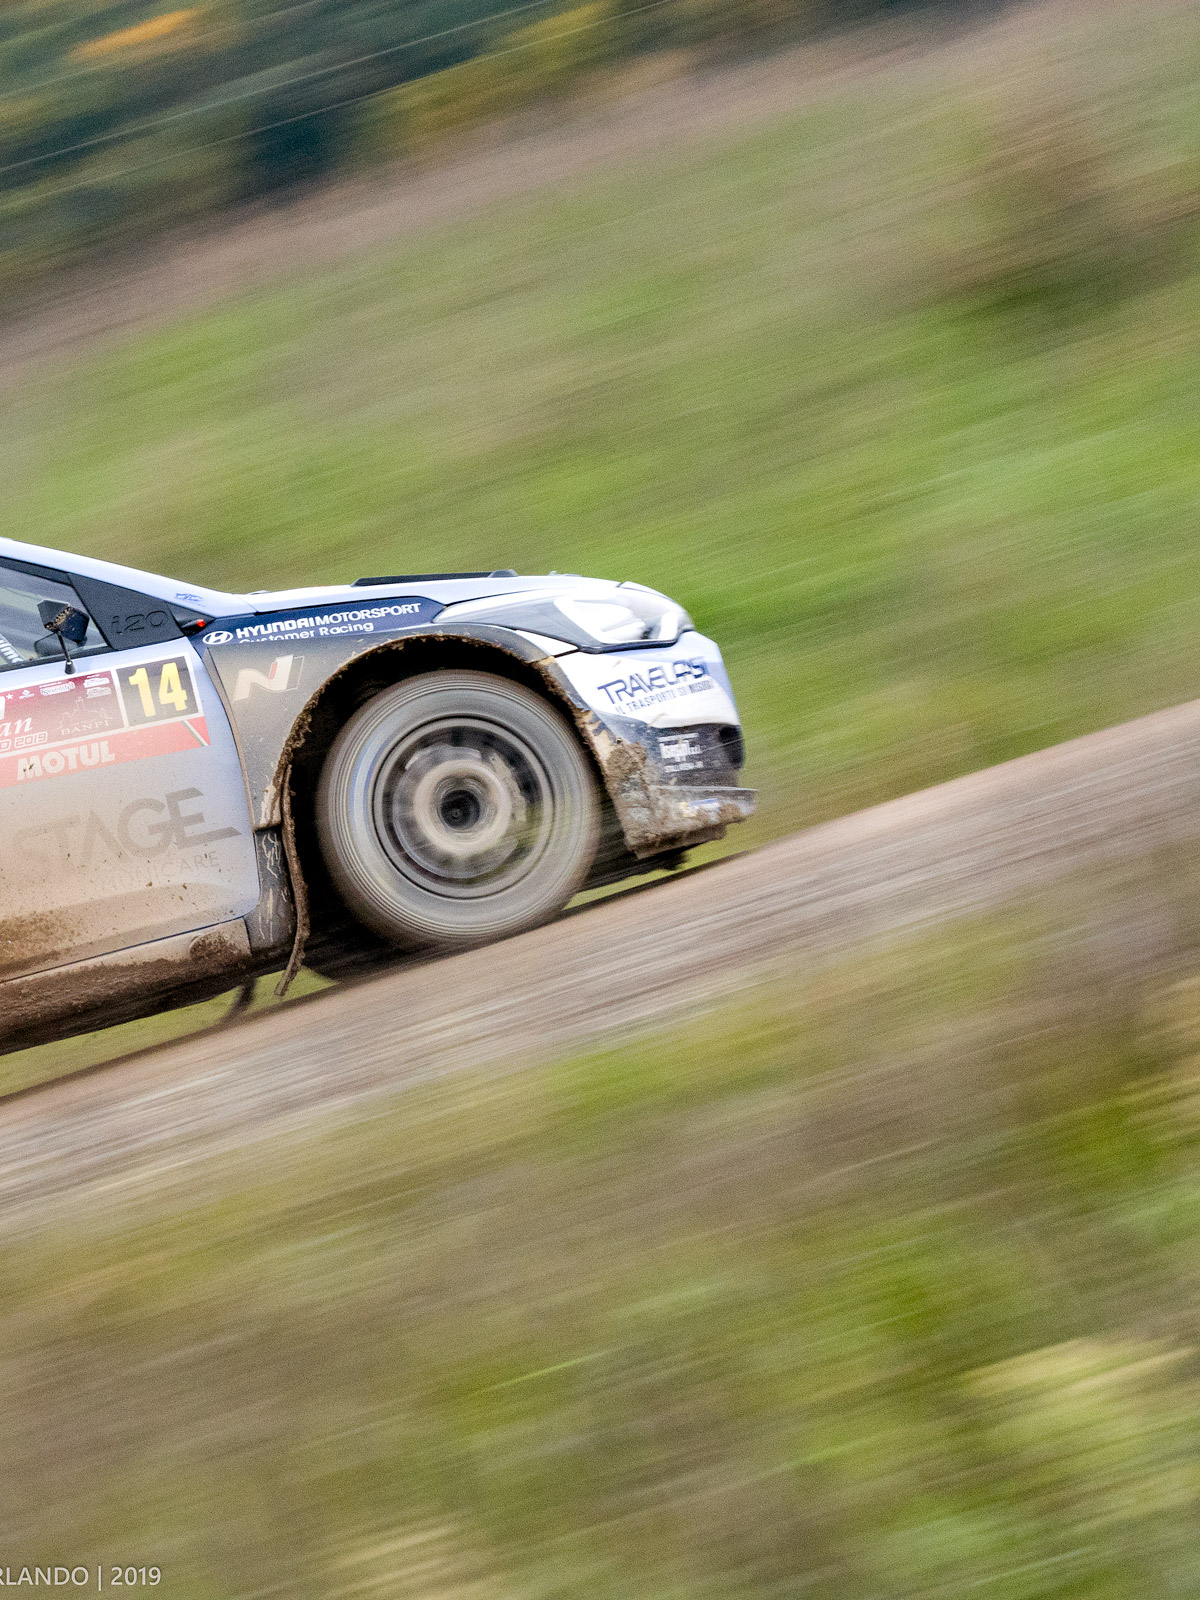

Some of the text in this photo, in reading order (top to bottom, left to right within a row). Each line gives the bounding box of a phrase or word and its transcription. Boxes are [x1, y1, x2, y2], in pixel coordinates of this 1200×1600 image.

[319, 621, 375, 637] Racing
[129, 662, 188, 717] 14
[14, 731, 48, 748] 2019
[17, 740, 116, 781] MOTUL
